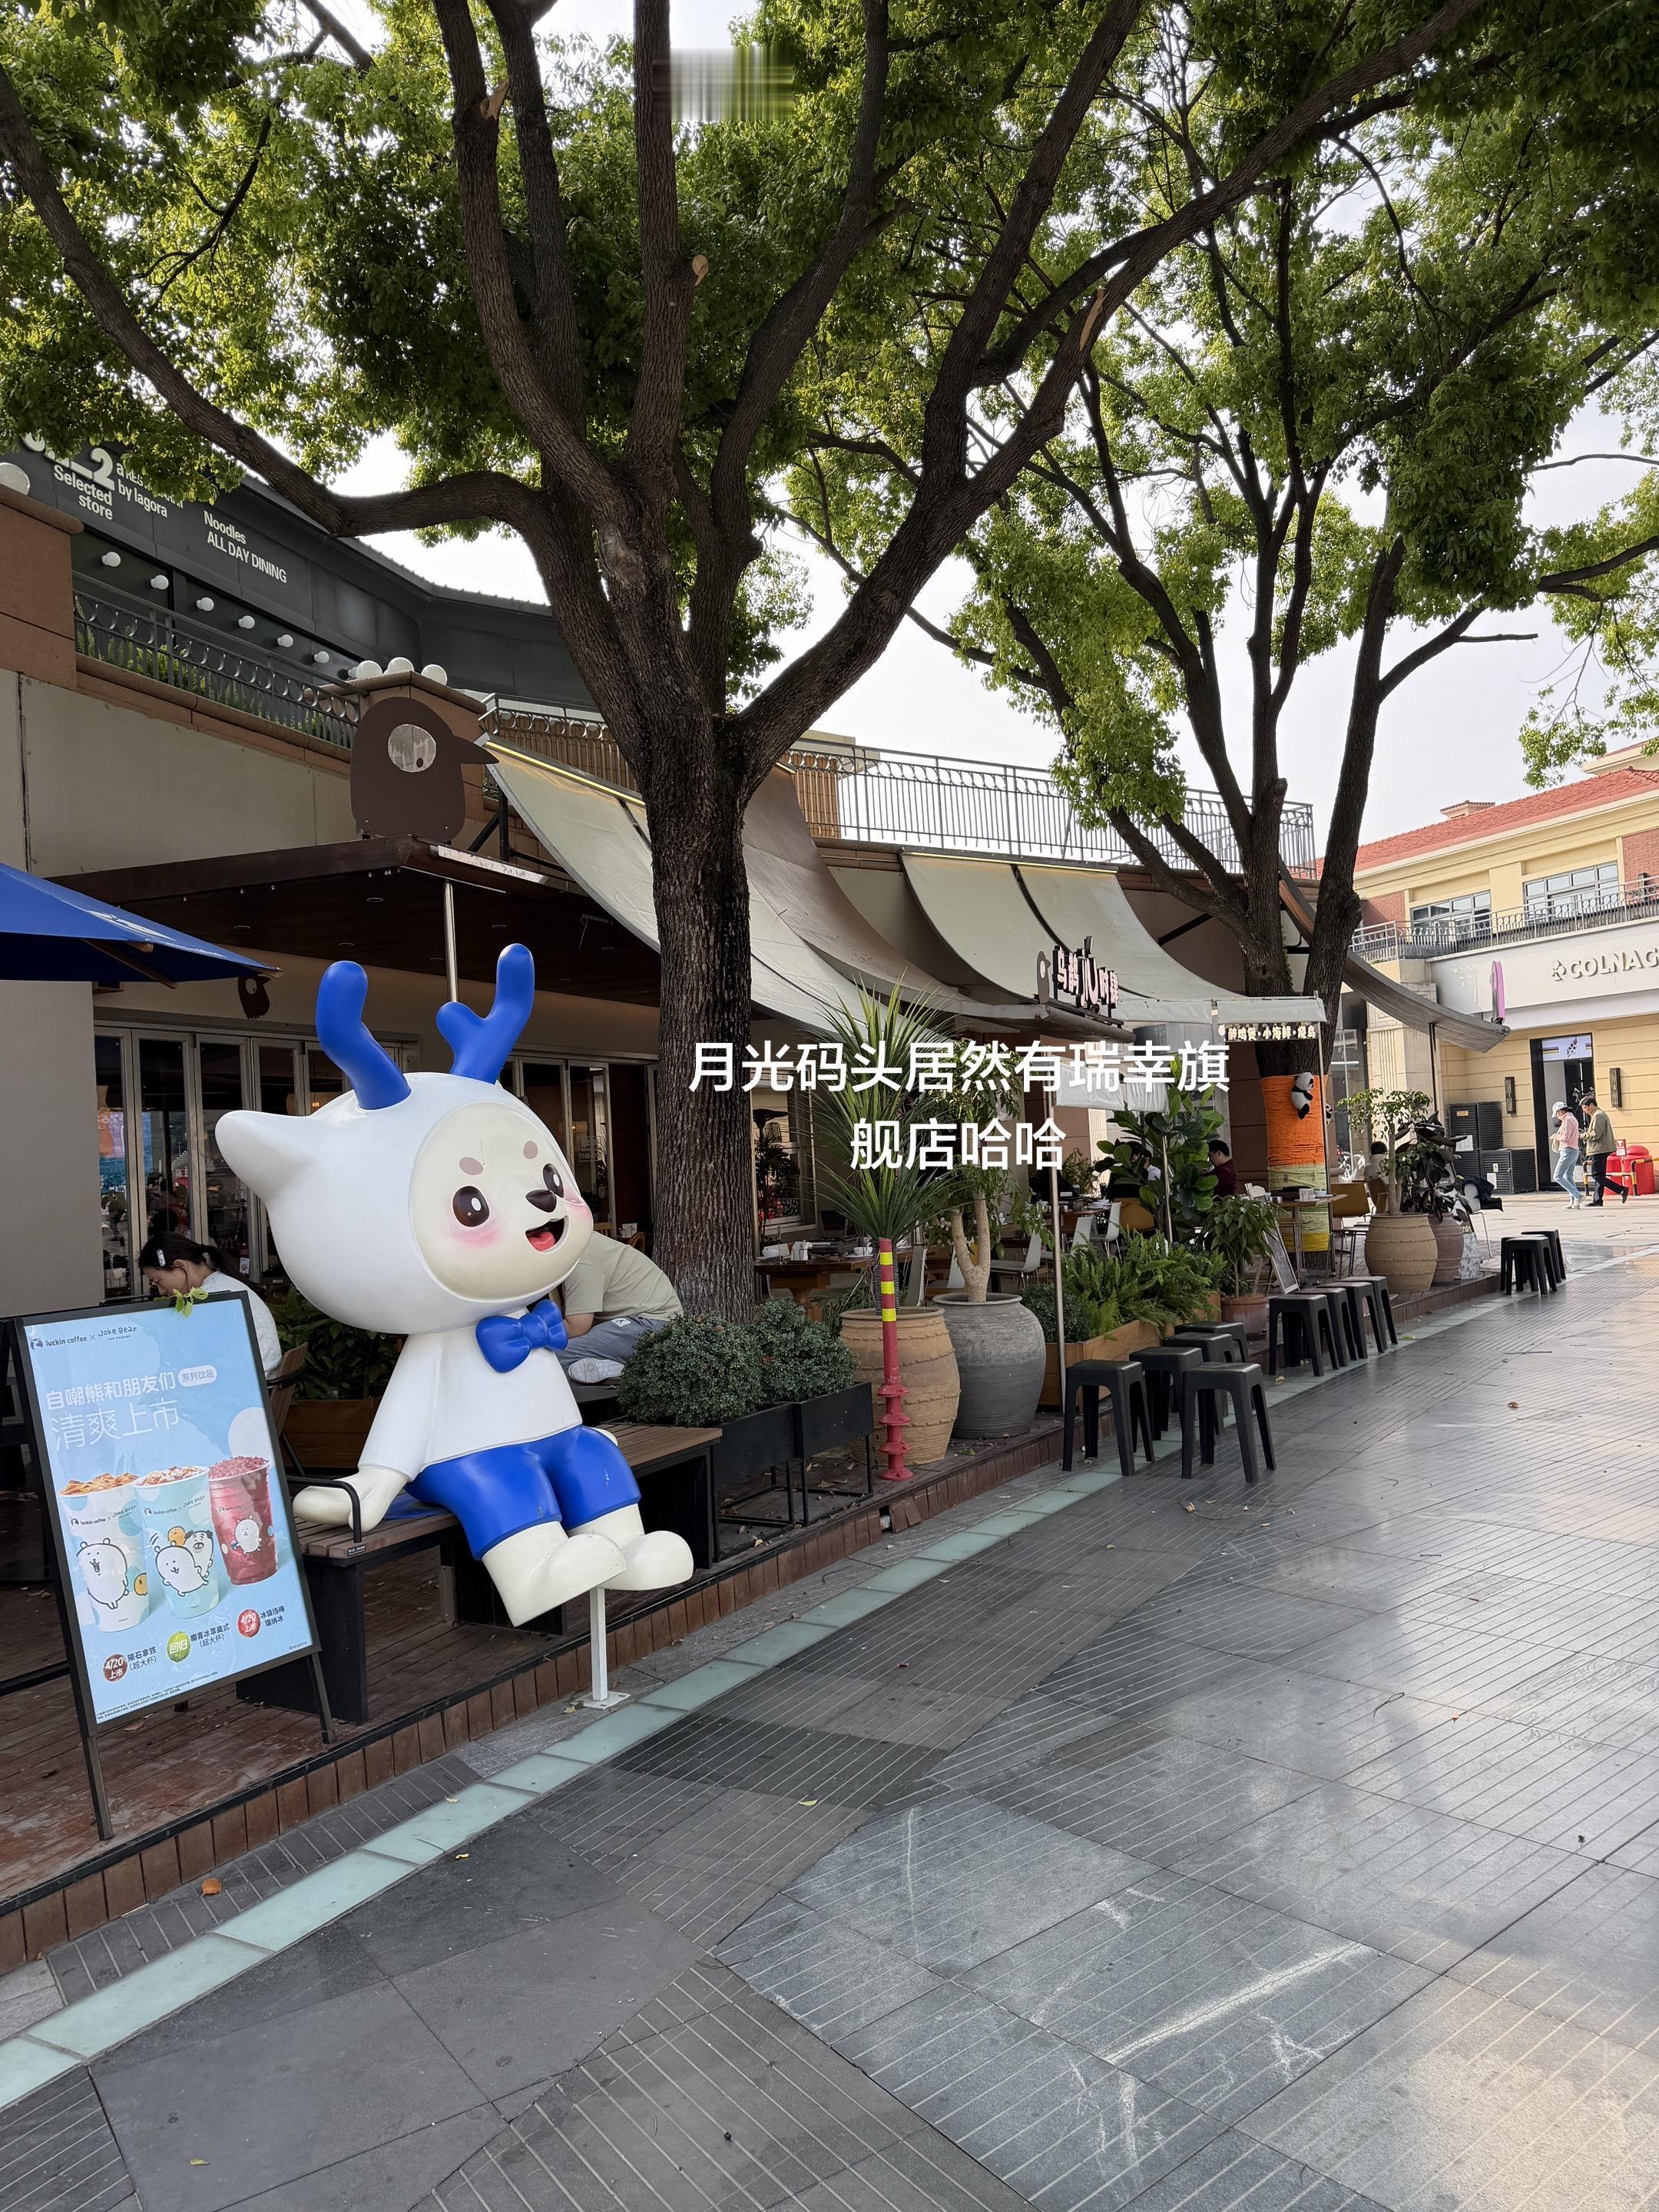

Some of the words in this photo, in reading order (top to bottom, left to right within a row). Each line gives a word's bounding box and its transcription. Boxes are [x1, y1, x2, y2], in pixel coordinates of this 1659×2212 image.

[54, 465, 112, 506] Selected
[118, 479, 132, 502] by
[134, 487, 167, 518] lagora
[78, 495, 113, 520] store
[204, 510, 246, 545] Noodles
[207, 531, 227, 552] ALL
[228, 541, 250, 563] DAY
[251, 553, 287, 583] DINING
[98, 1327, 116, 1336] Joke
[46, 1371, 175, 1410] 自嘲熊和朋友们
[181, 1369, 214, 1382] 系列饮品
[51, 1396, 179, 1451] 清爽上市
[105, 1657, 124, 1670] 4/20
[169, 1640, 188, 1654] 回归
[109, 1668, 123, 1679] 上市
